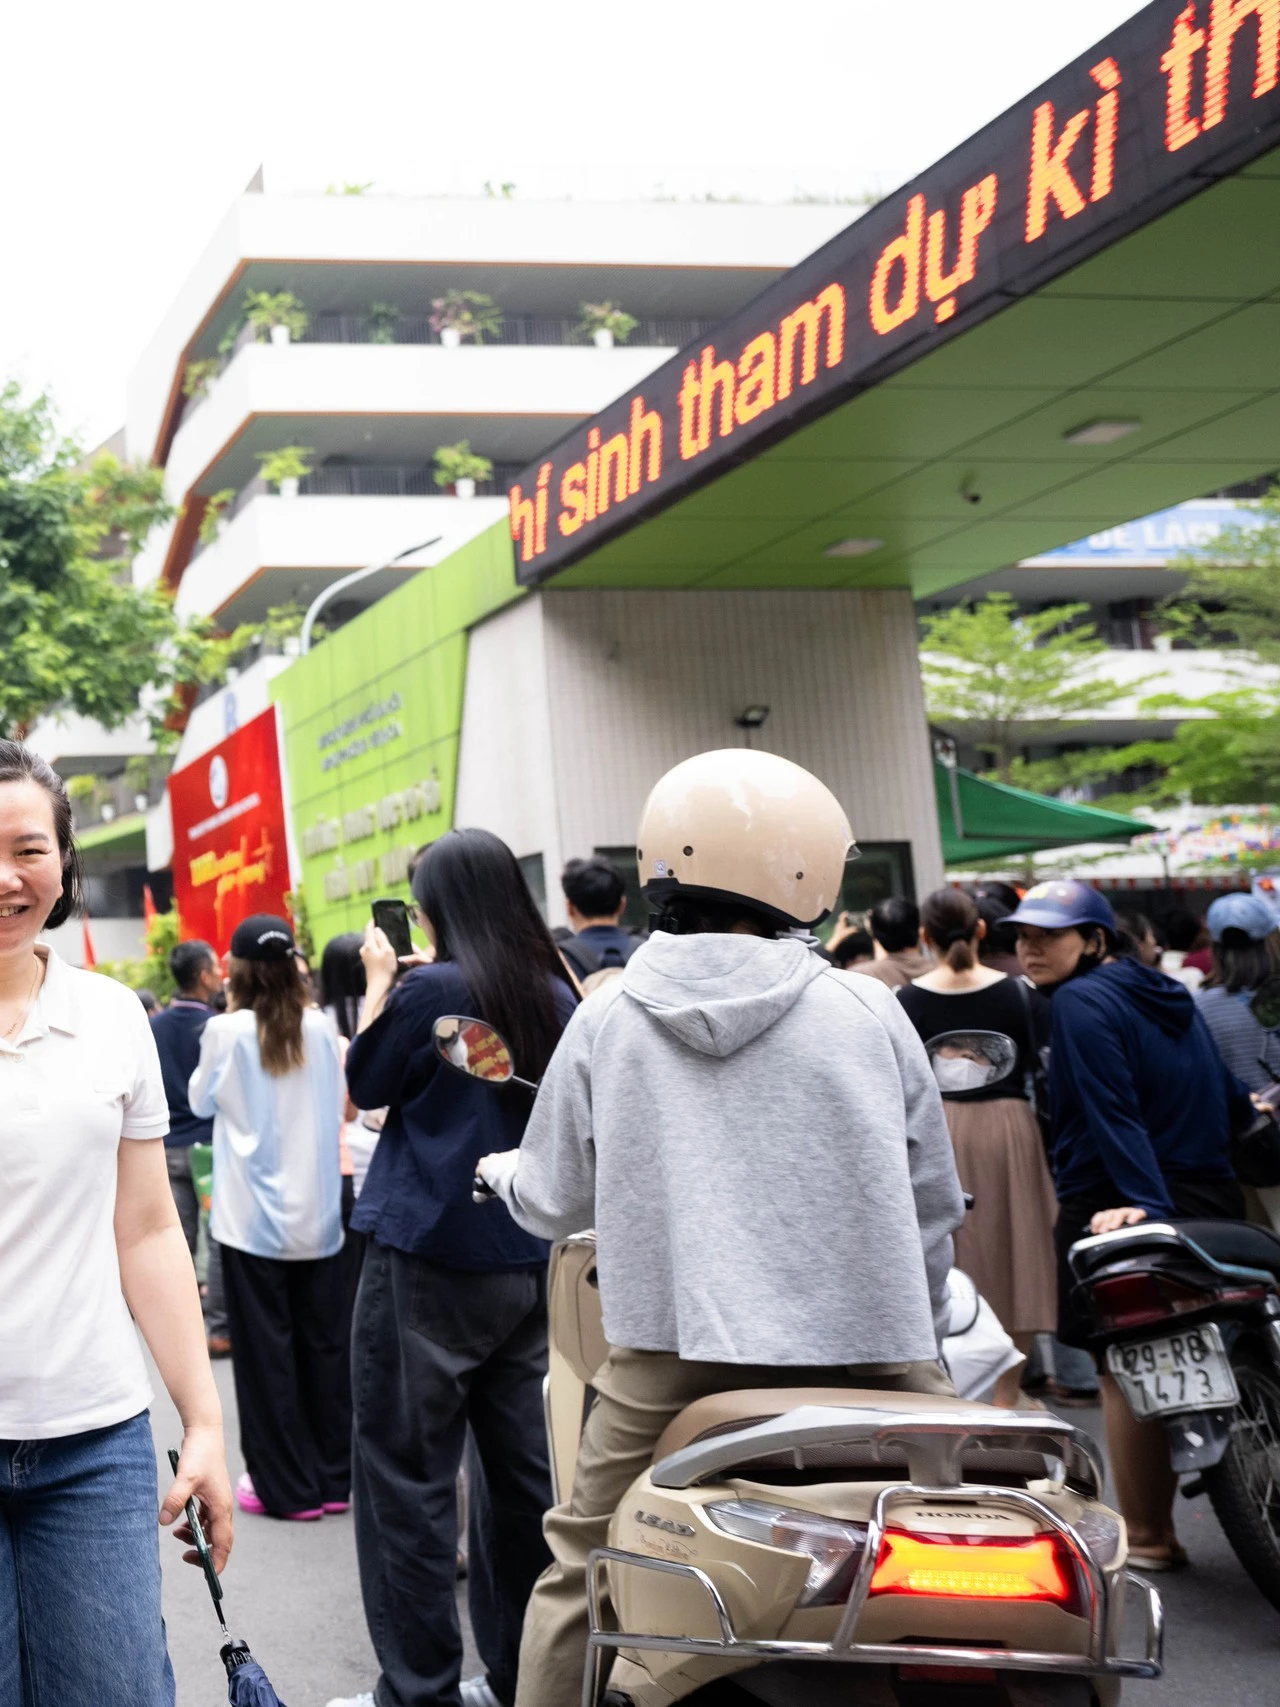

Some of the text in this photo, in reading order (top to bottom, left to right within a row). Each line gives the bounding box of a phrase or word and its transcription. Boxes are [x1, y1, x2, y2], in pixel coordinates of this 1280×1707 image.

[558, 395, 662, 537] sinh
[677, 282, 846, 461] tham
[869, 174, 998, 335] dự
[1024, 57, 1122, 244] kì
[1132, 1369, 1213, 1412] 7473
[915, 1511, 1013, 1521] HONDA
